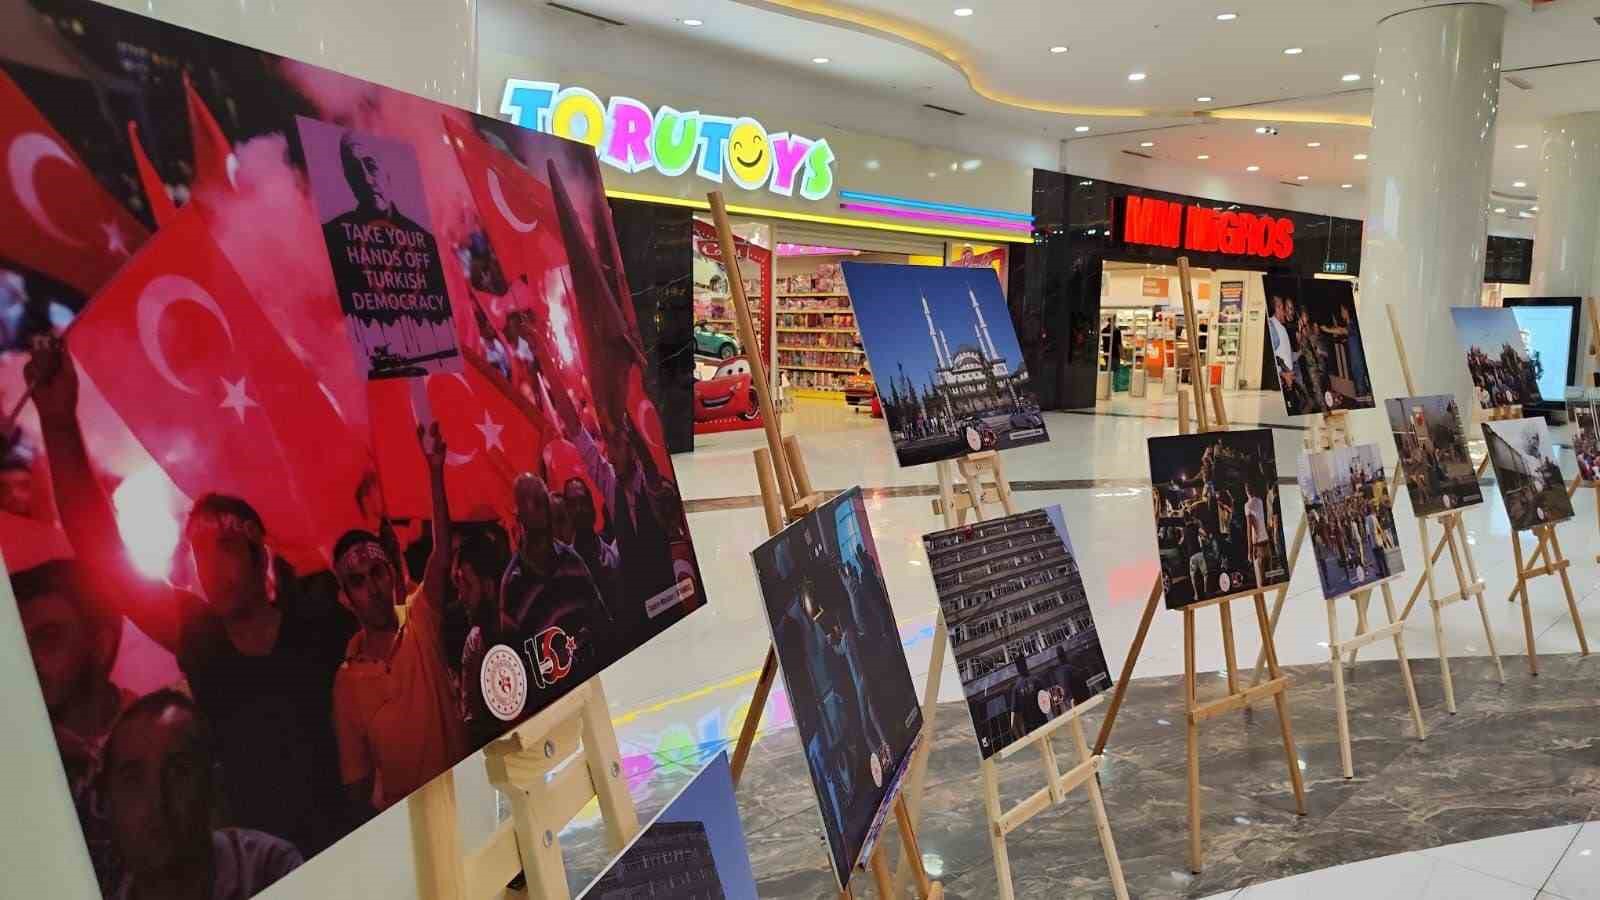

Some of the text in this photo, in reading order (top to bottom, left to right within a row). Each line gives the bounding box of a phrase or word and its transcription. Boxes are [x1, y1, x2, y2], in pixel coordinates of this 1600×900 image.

[342, 223, 426, 247] TAKE YOUR
[346, 247, 431, 269] HANDS OFF
[363, 270, 427, 289] TURKISH
[352, 292, 444, 310] DEMOCRACY
